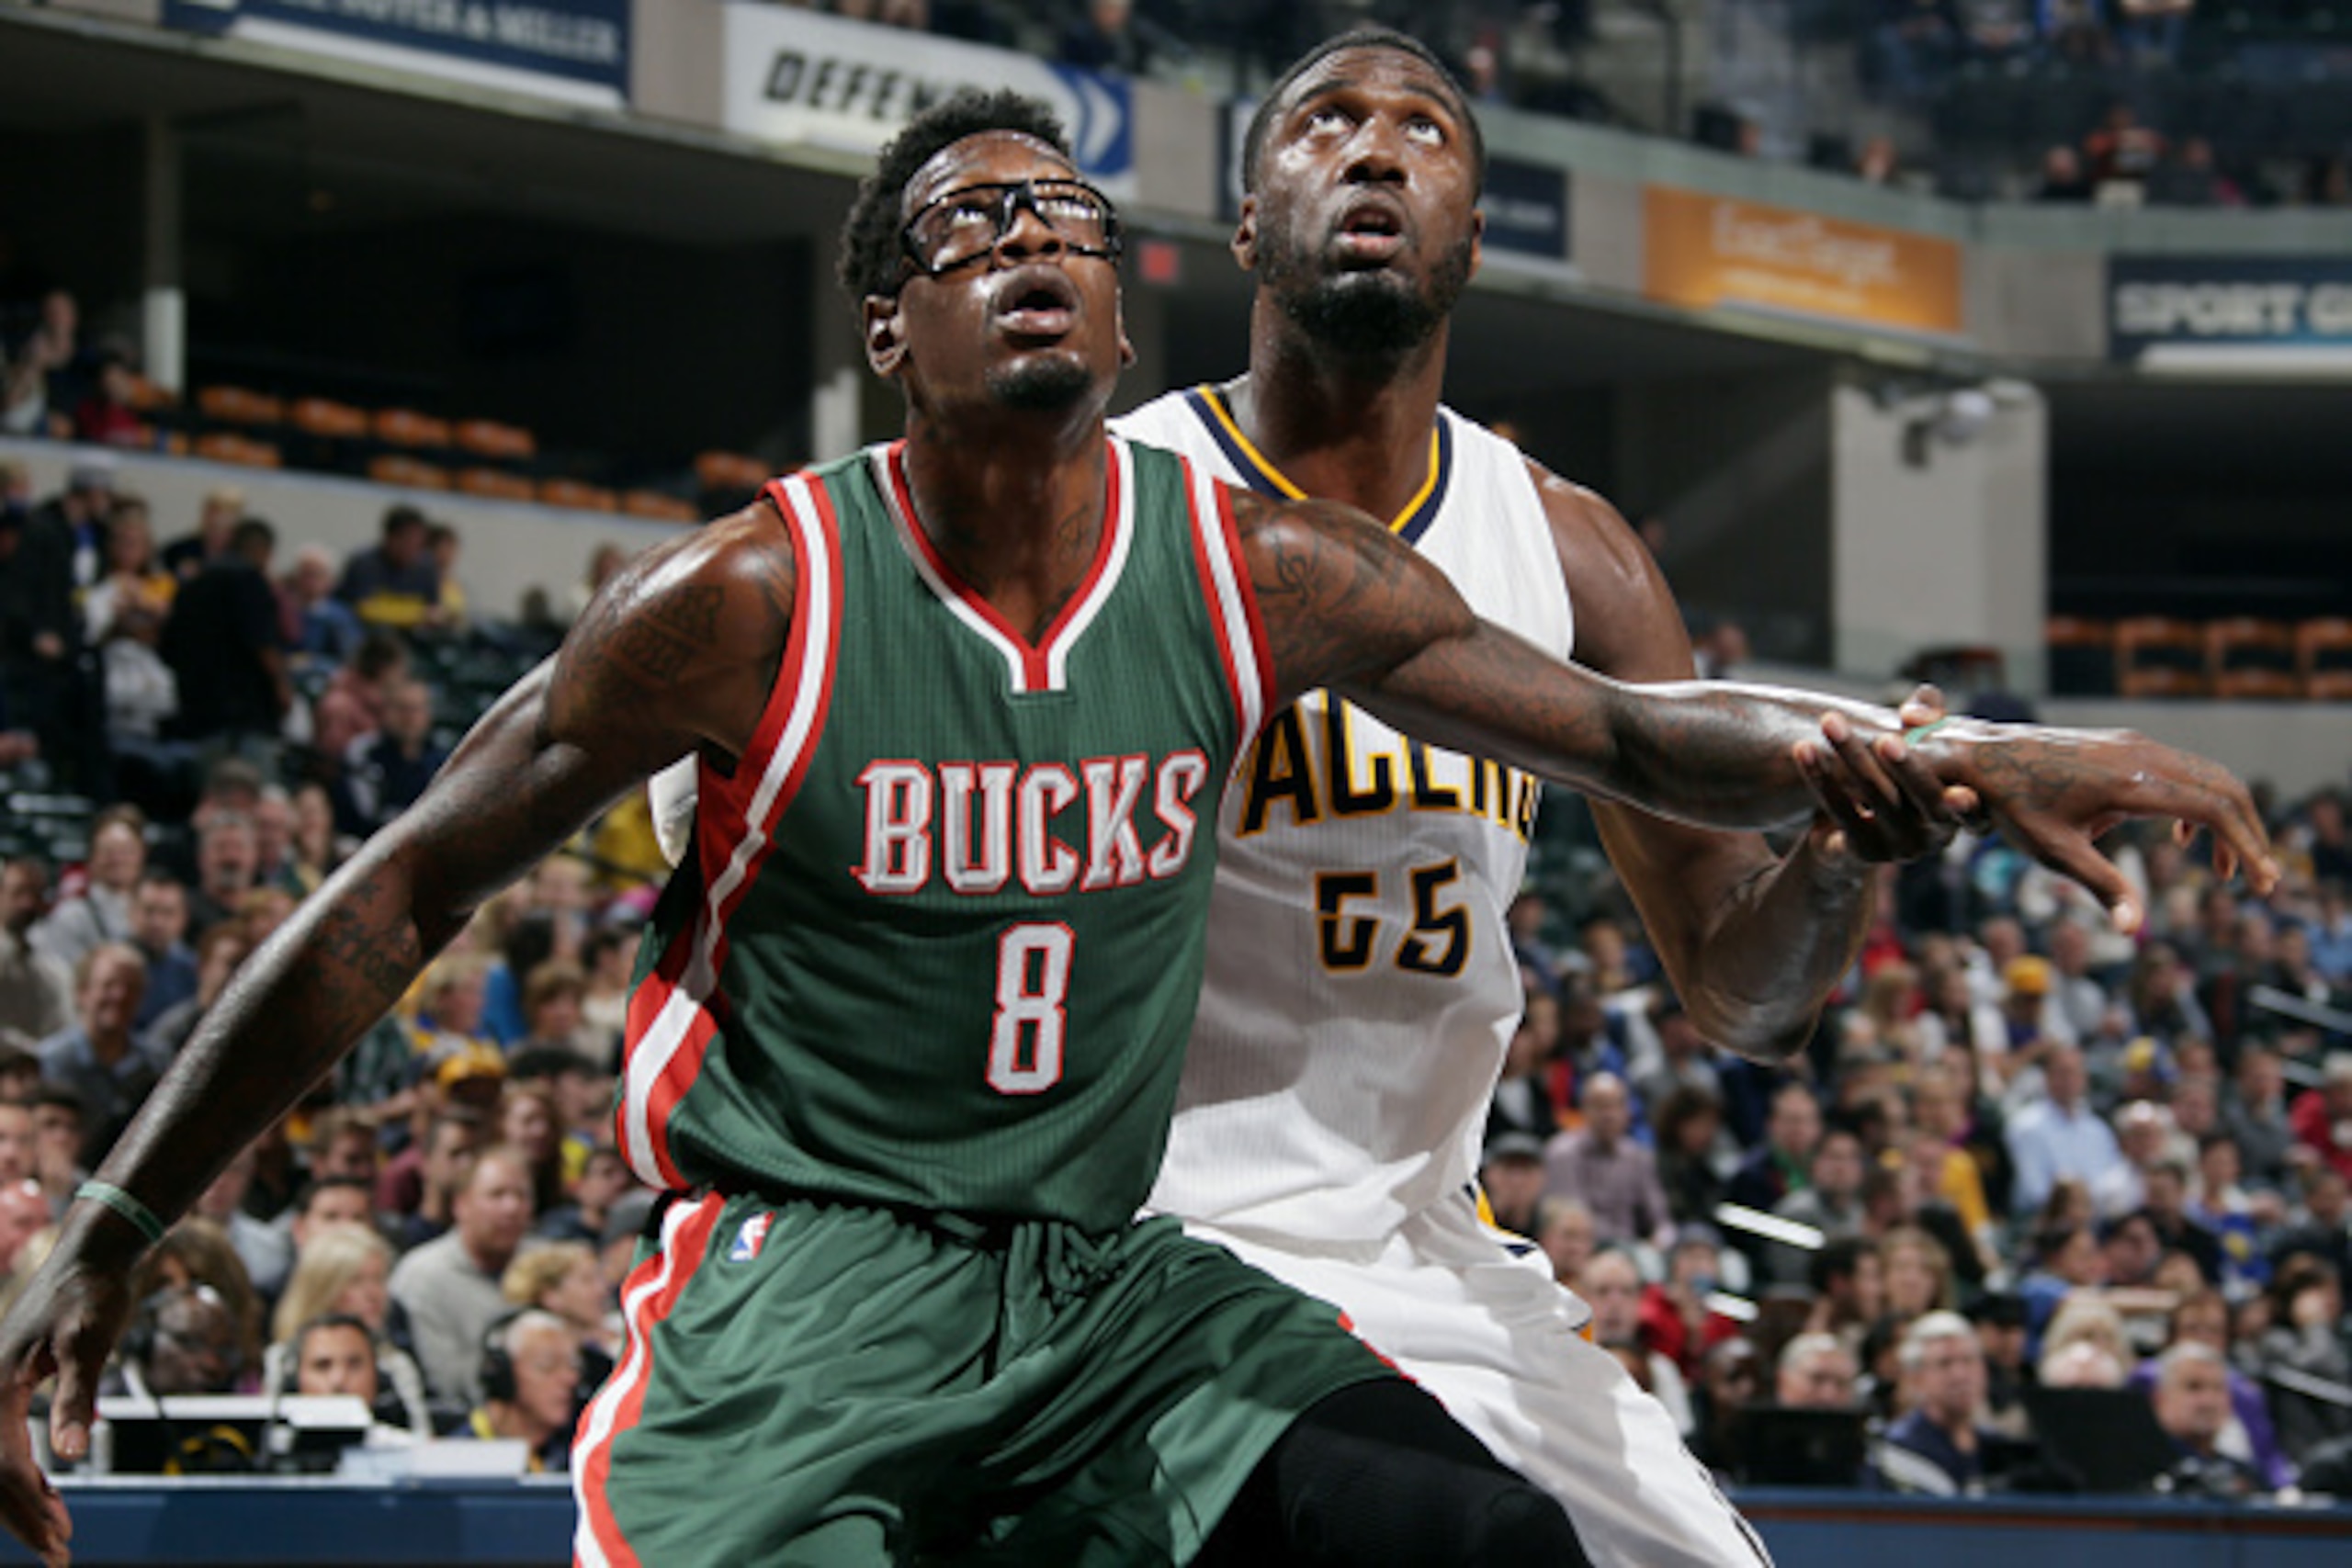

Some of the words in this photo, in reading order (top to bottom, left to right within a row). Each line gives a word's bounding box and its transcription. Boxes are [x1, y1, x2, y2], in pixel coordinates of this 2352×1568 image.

[763, 49, 976, 126] DEFEN
[2116, 281, 2299, 336] SPORT
[849, 747, 1209, 897] BUCKS
[1315, 856, 1472, 980] 55
[985, 920, 1077, 1095] 8
